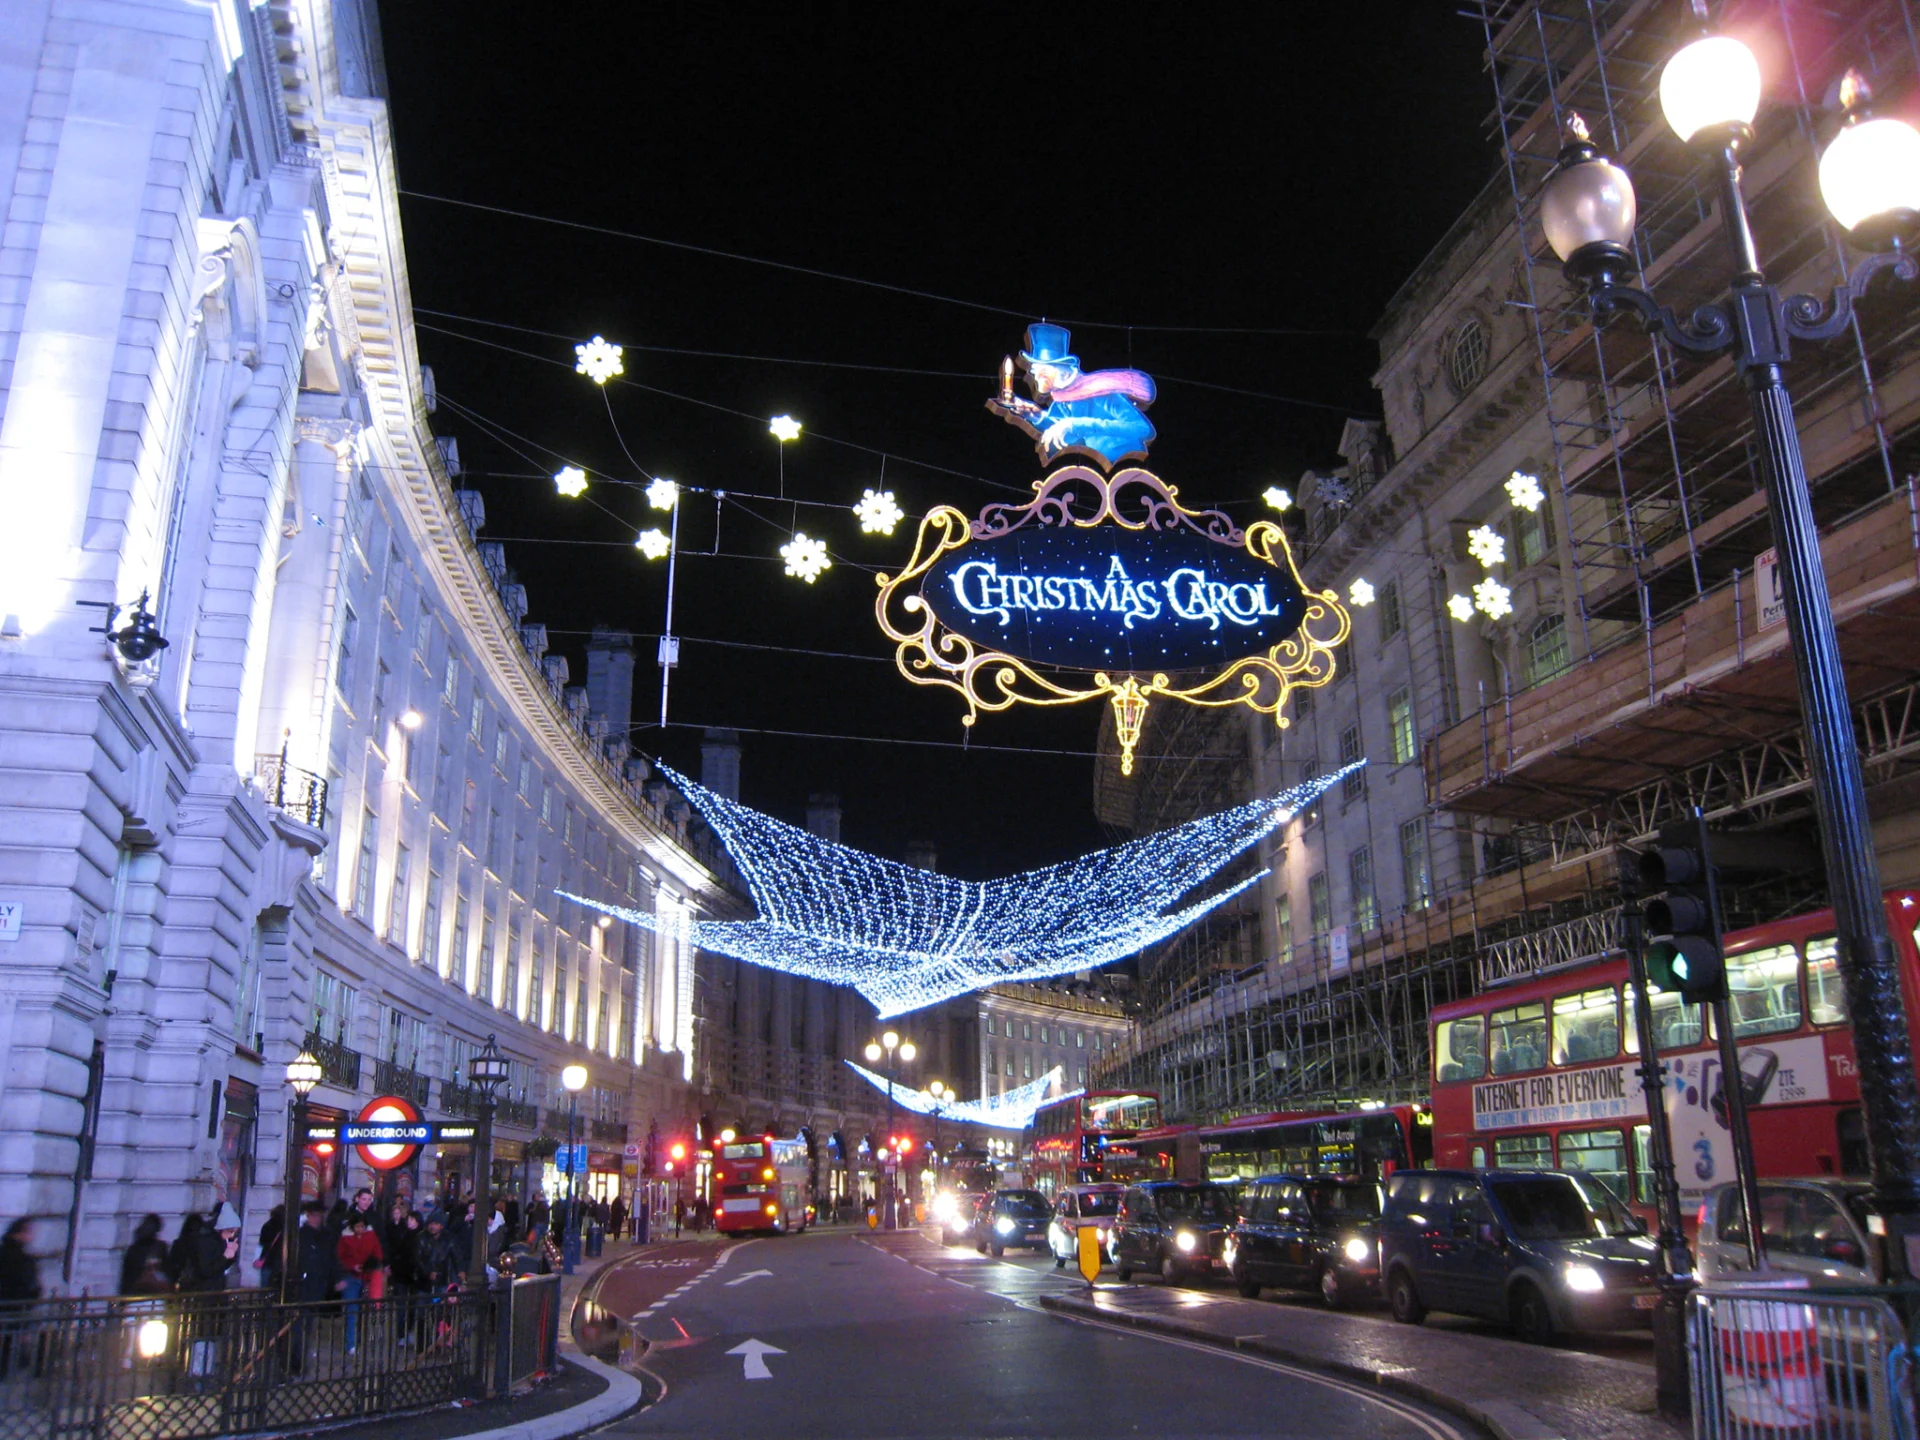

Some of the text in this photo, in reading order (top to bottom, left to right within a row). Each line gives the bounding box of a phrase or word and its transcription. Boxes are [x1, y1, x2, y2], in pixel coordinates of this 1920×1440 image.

[1106, 554, 1130, 579] A
[948, 561, 1280, 630] CHRISTMAS CAROL
[1778, 1069, 1796, 1087] ZTE
[1475, 1066, 1626, 1113] INTERNET FOR EVERYONE
[309, 1128, 336, 1138] PUBLIC
[347, 1127, 427, 1138] UNDERGROUND
[440, 1128, 475, 1137] SUBWAY
[1337, 1129, 1356, 1141] Arrow
[1693, 1139, 1714, 1182] 3
